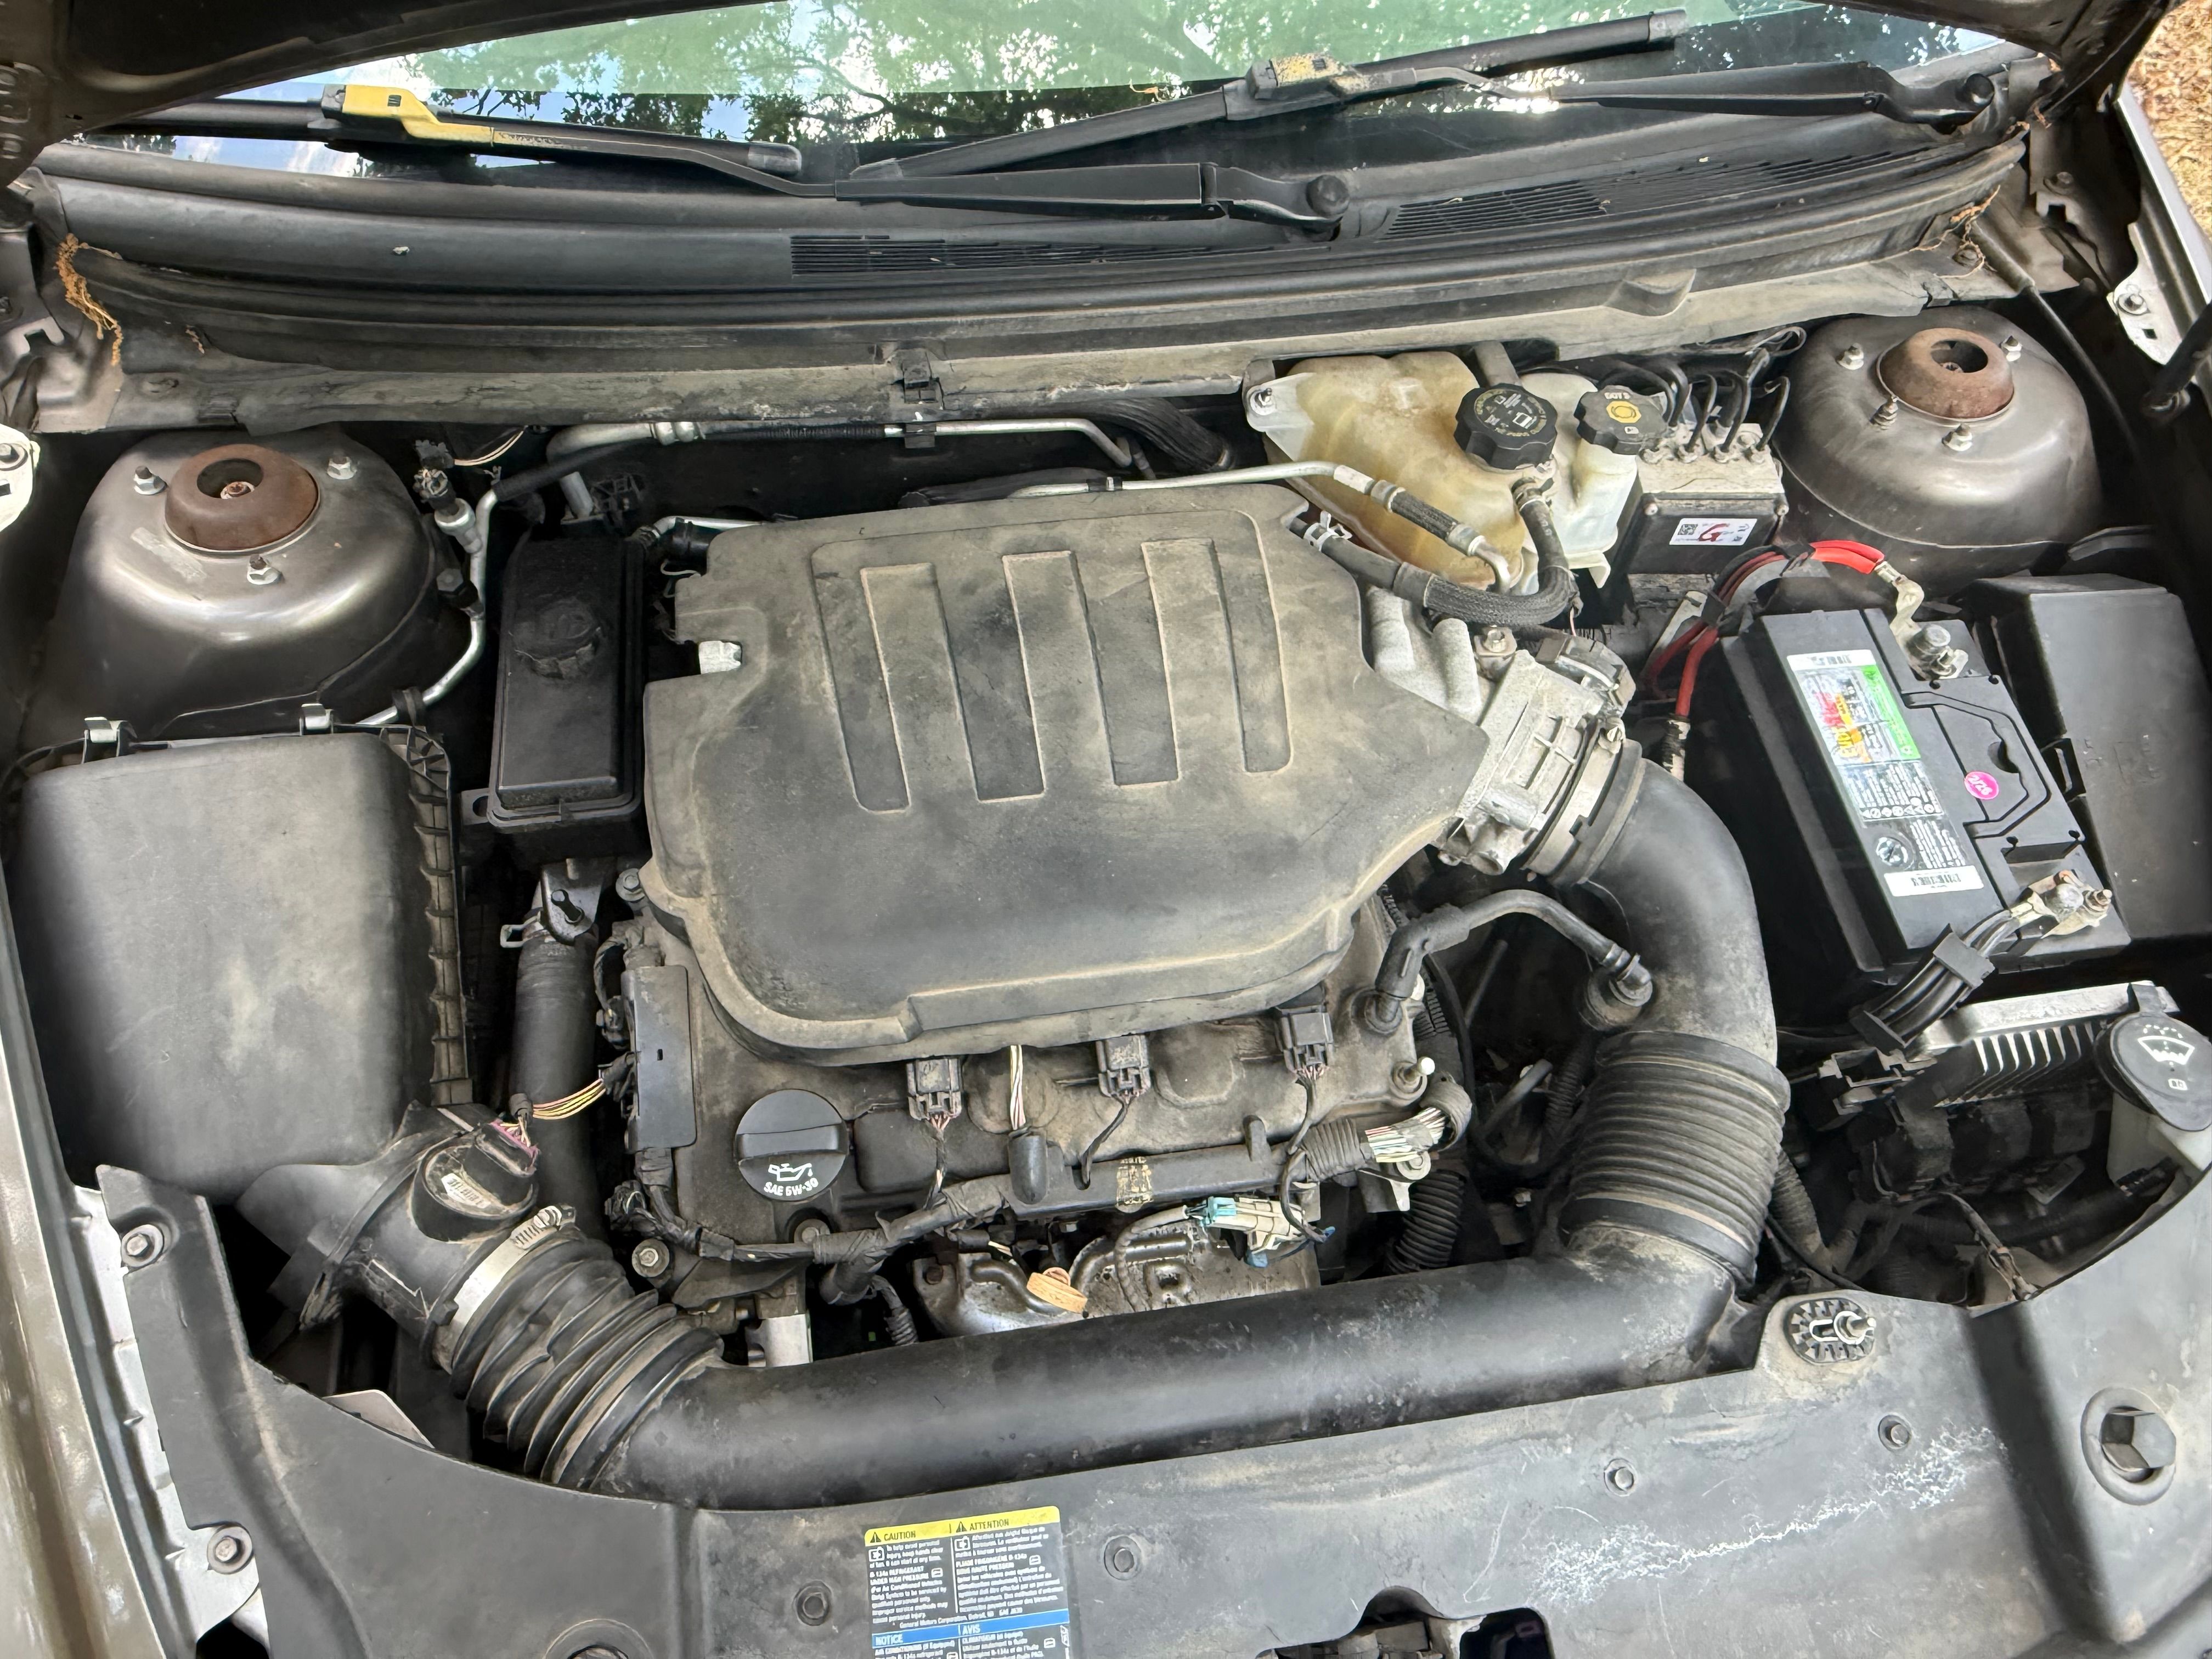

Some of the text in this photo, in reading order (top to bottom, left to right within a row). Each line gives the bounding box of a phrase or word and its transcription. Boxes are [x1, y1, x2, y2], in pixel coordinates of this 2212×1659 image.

[764, 1182, 783, 1196] SAE
[969, 1519, 1009, 1531] ATTENTION
[884, 1530, 916, 1541] CAUTION
[962, 1624, 981, 1635] AVIS
[875, 1634, 904, 1646] NOTICE
